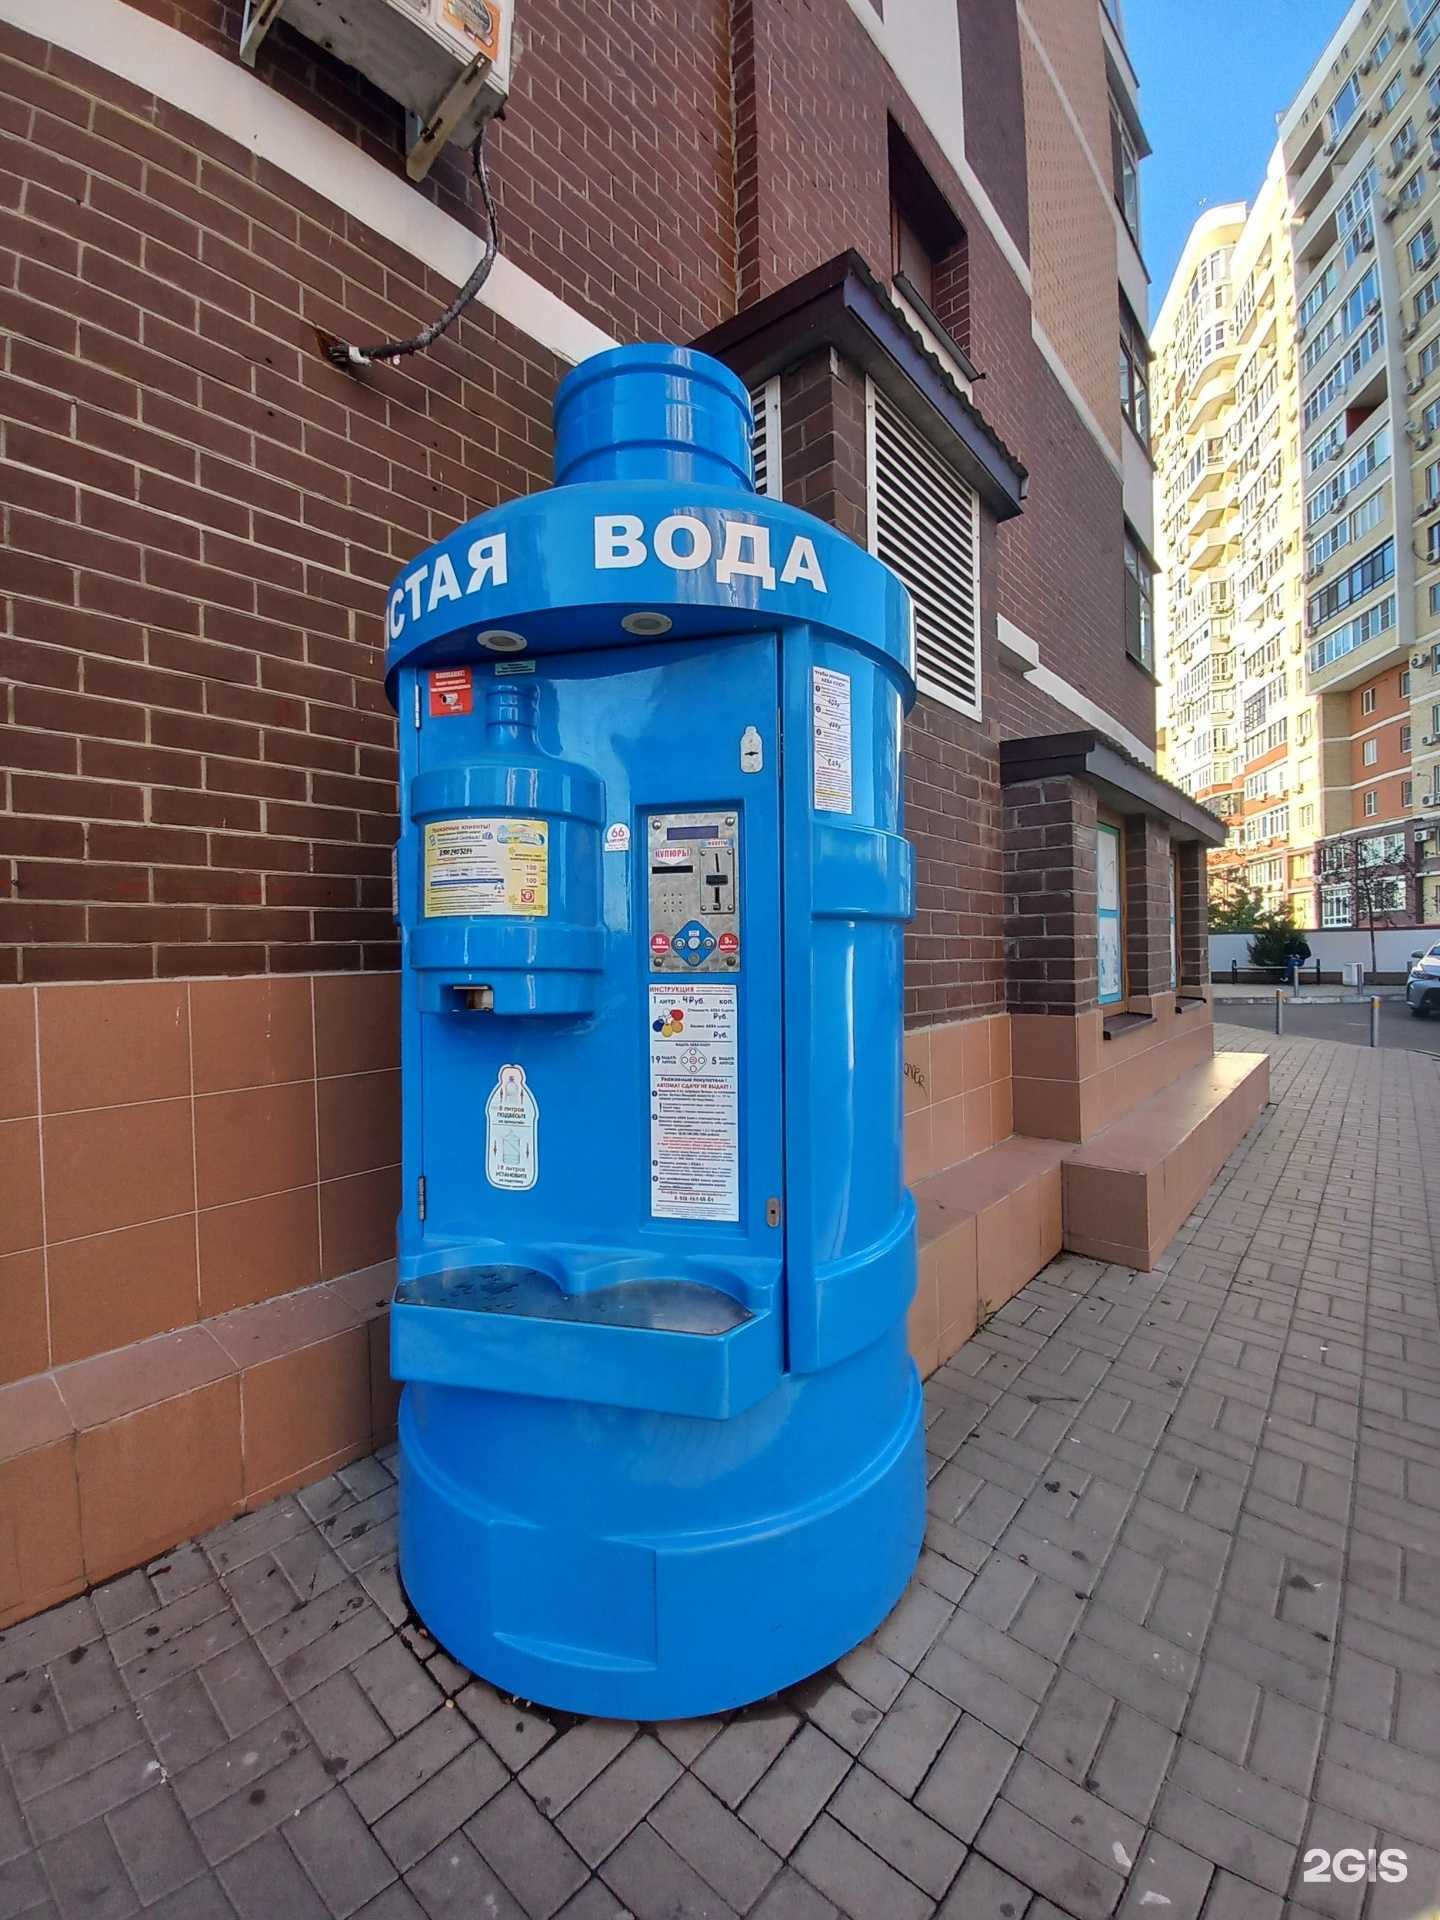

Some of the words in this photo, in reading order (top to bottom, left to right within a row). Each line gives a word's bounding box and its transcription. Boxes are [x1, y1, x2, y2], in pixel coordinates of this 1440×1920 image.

[386, 532, 508, 650] СТАЯ
[594, 514, 829, 594] ВОДА
[611, 827, 625, 838] 66
[655, 848, 690, 859] КУПЮРЫ
[649, 986, 695, 994] ИНСТРУКЦИЯ
[651, 1056, 661, 1065] 19
[711, 1056, 717, 1065] 5
